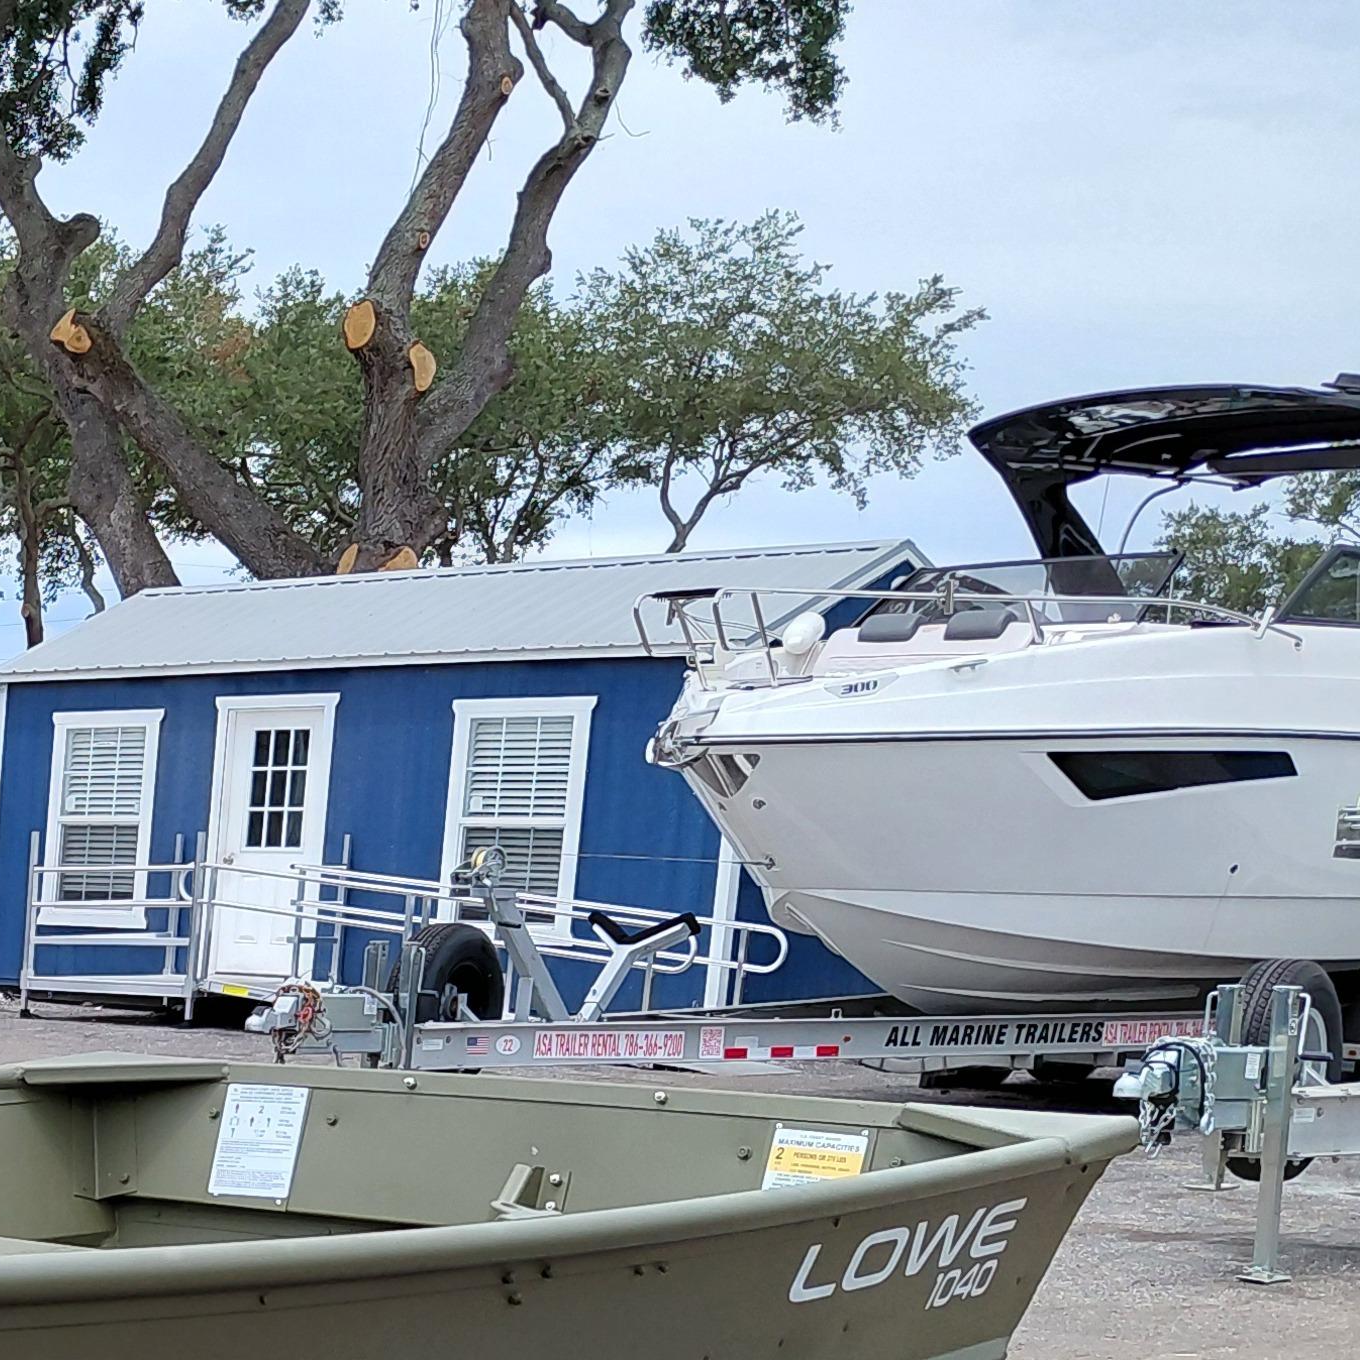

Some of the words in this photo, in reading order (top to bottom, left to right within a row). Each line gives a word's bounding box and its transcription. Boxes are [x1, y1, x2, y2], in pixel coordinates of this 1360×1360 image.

[840, 679, 878, 695] 300
[502, 1038, 514, 1052] 22
[535, 1033, 553, 1057] ASA
[555, 1033, 591, 1057] TRAILER
[591, 1033, 622, 1057] RENTAL
[623, 1032, 683, 1058] 786-366-9200
[884, 1025, 921, 1047] ALL
[929, 1023, 1008, 1046] MARINE
[1014, 1021, 1104, 1045] TRAILERS
[775, 1147, 785, 1160] 2
[789, 1197, 1028, 1303] LOWE
[924, 1259, 998, 1310] 1040
